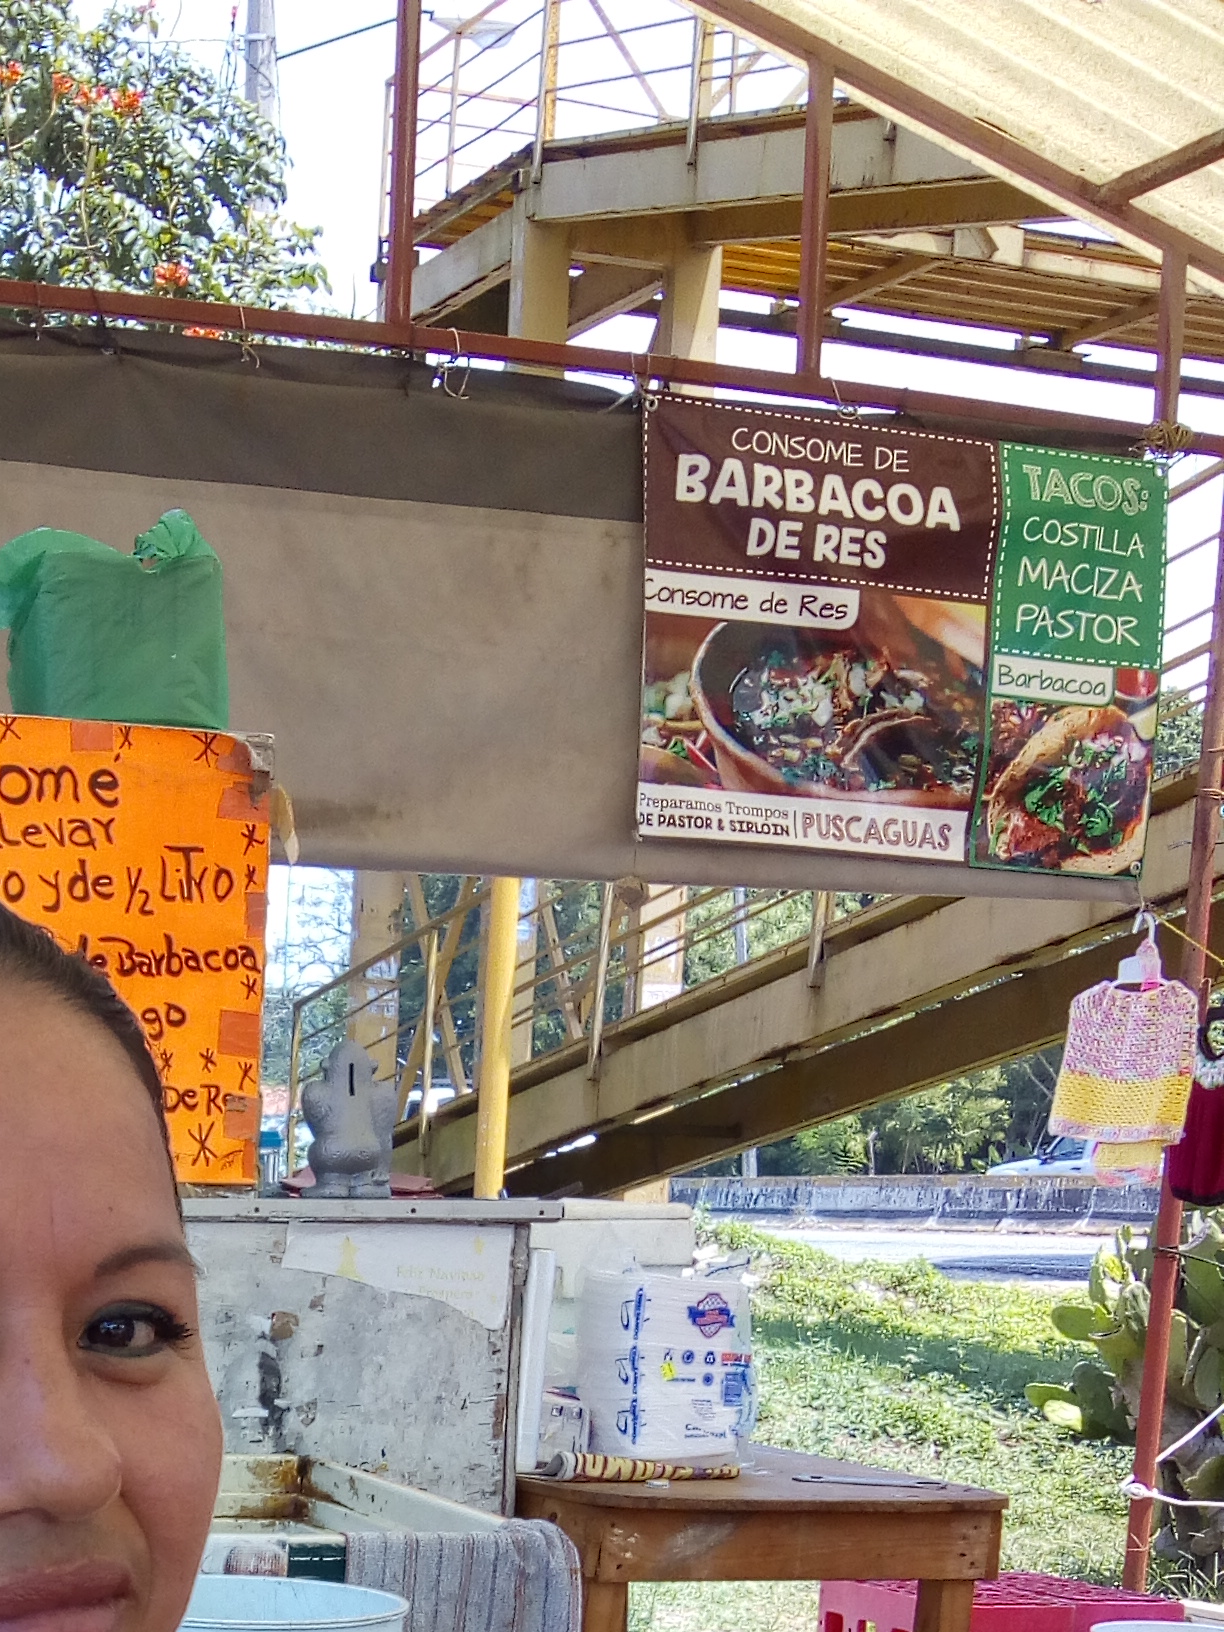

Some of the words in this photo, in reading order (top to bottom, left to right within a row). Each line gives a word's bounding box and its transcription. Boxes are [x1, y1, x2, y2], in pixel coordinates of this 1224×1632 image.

[732, 427, 864, 467] CONSOME
[875, 446, 909, 472] DE
[675, 453, 961, 532] BARBACOA
[1022, 464, 1149, 516] TACOS:
[746, 517, 803, 560] DE
[813, 524, 887, 569] RES
[1023, 516, 1145, 559] COSTILLA
[1017, 555, 1143, 603] MACIZA
[759, 592, 788, 614] de
[799, 595, 848, 620] Res
[1016, 603, 1140, 647] PASTOR
[998, 664, 1106, 696] Barbacoa
[639, 793, 721, 812] Preparamos
[726, 801, 789, 820] Trompos
[658, 813, 712, 830] PASTOR
[717, 819, 725, 832] &
[730, 820, 790, 837] SIRLOIN
[802, 813, 951, 851] PUSCAGUAS
[98, 933, 259, 977] Barbacoa
